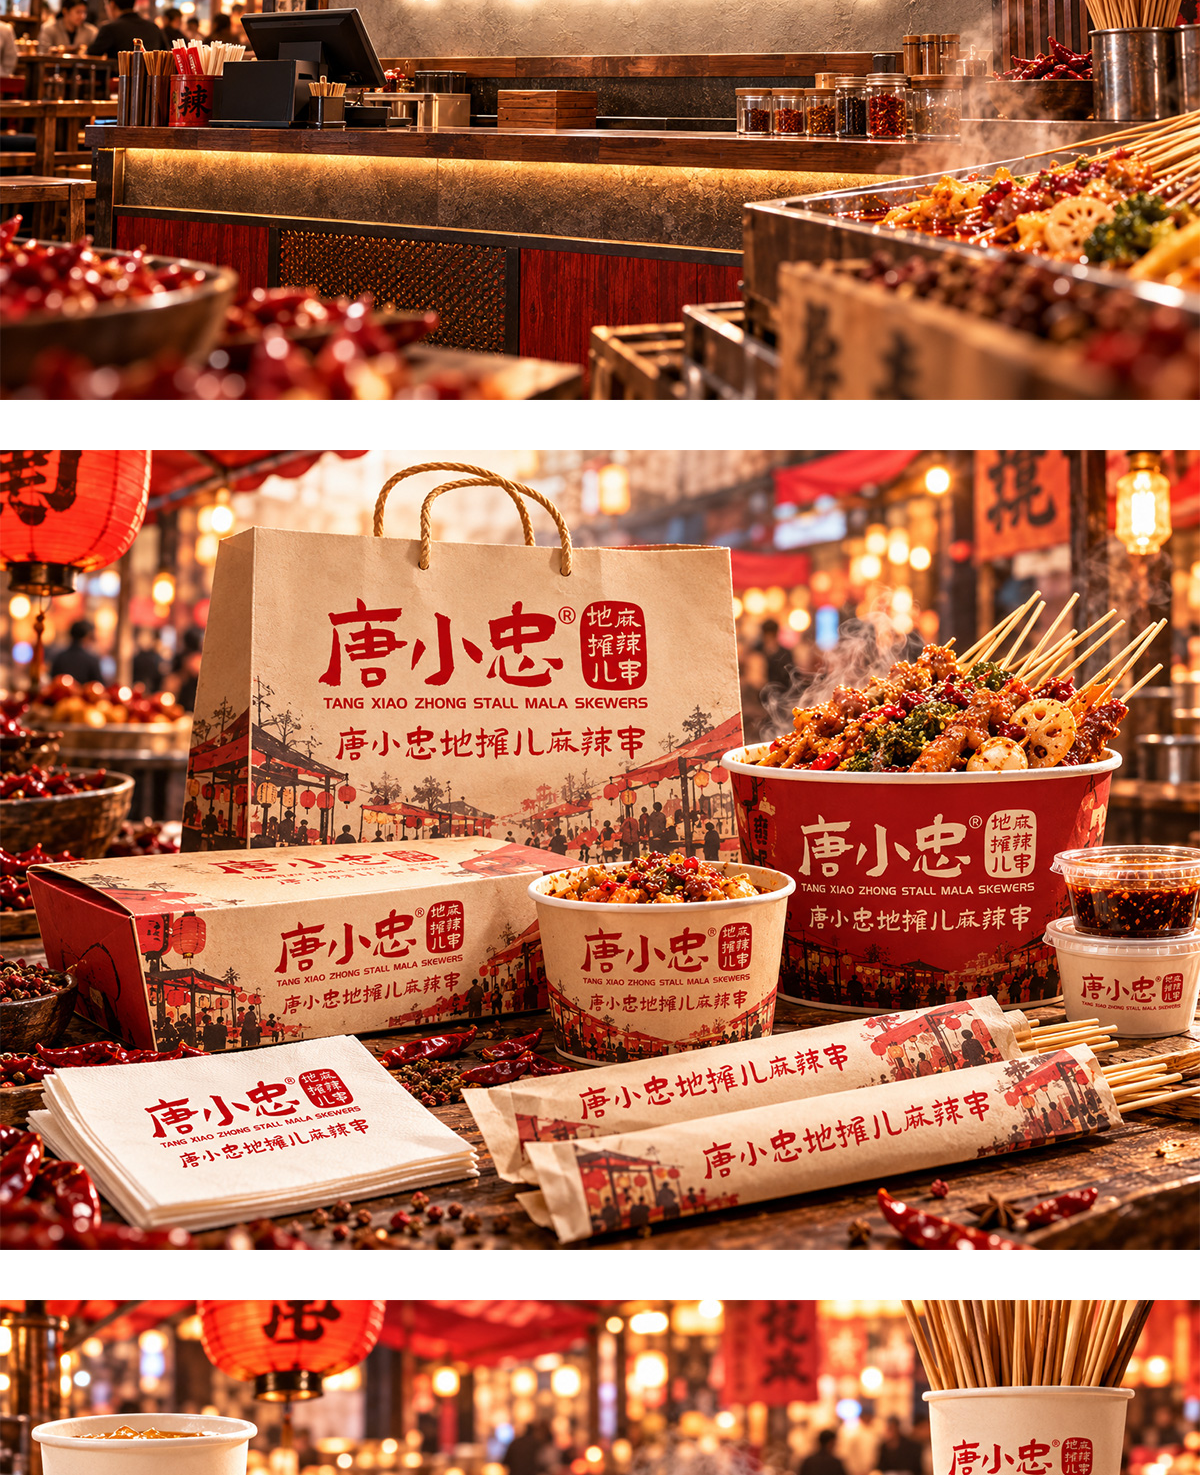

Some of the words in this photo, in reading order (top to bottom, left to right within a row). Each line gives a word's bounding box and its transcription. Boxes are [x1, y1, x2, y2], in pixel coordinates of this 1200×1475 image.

[178, 84, 211, 118] 辣
[319, 598, 563, 688] 唐小忠
[587, 605, 615, 684] 地摊儿
[615, 607, 643, 686] 麻辣串
[323, 698, 363, 709] TANG
[372, 698, 407, 709] XIAO
[415, 698, 466, 709] ZHONG
[474, 698, 518, 709] STALL
[525, 698, 568, 708] MALA
[575, 698, 648, 708] SKEWERS
[336, 725, 646, 761] 唐小忠地摊儿麻辣串
[799, 814, 971, 878] 唐小忠
[990, 813, 1011, 874] 地摊儿
[1012, 814, 1034, 874] 麻辣串
[801, 883, 827, 893] TANG
[830, 885, 854, 894] XIAO
[859, 886, 896, 895] ZHONG
[902, 885, 936, 895] STALL
[941, 886, 973, 895] MALA
[979, 883, 1034, 894] SKEWERS
[274, 908, 417, 974] 唐小忠
[810, 904, 1031, 933] 唐小忠地摊儿麻辣串
[581, 927, 709, 973] 唐小忠
[282, 971, 461, 1016] 唐小忠地摊儿麻辣串
[589, 990, 748, 1013] 唐小忠地摊儿麻辣串
[1081, 973, 1156, 1003] 唐小忠
[578, 1042, 849, 1121] 唐小忠地摊儿麻辣串
[145, 1080, 300, 1139] 唐小忠
[703, 1089, 990, 1180] 唐小忠地摊儿麻辣串
[179, 1117, 368, 1168] 唐小忠地摊儿麻辣串
[949, 1439, 1053, 1475] 唐小忠
